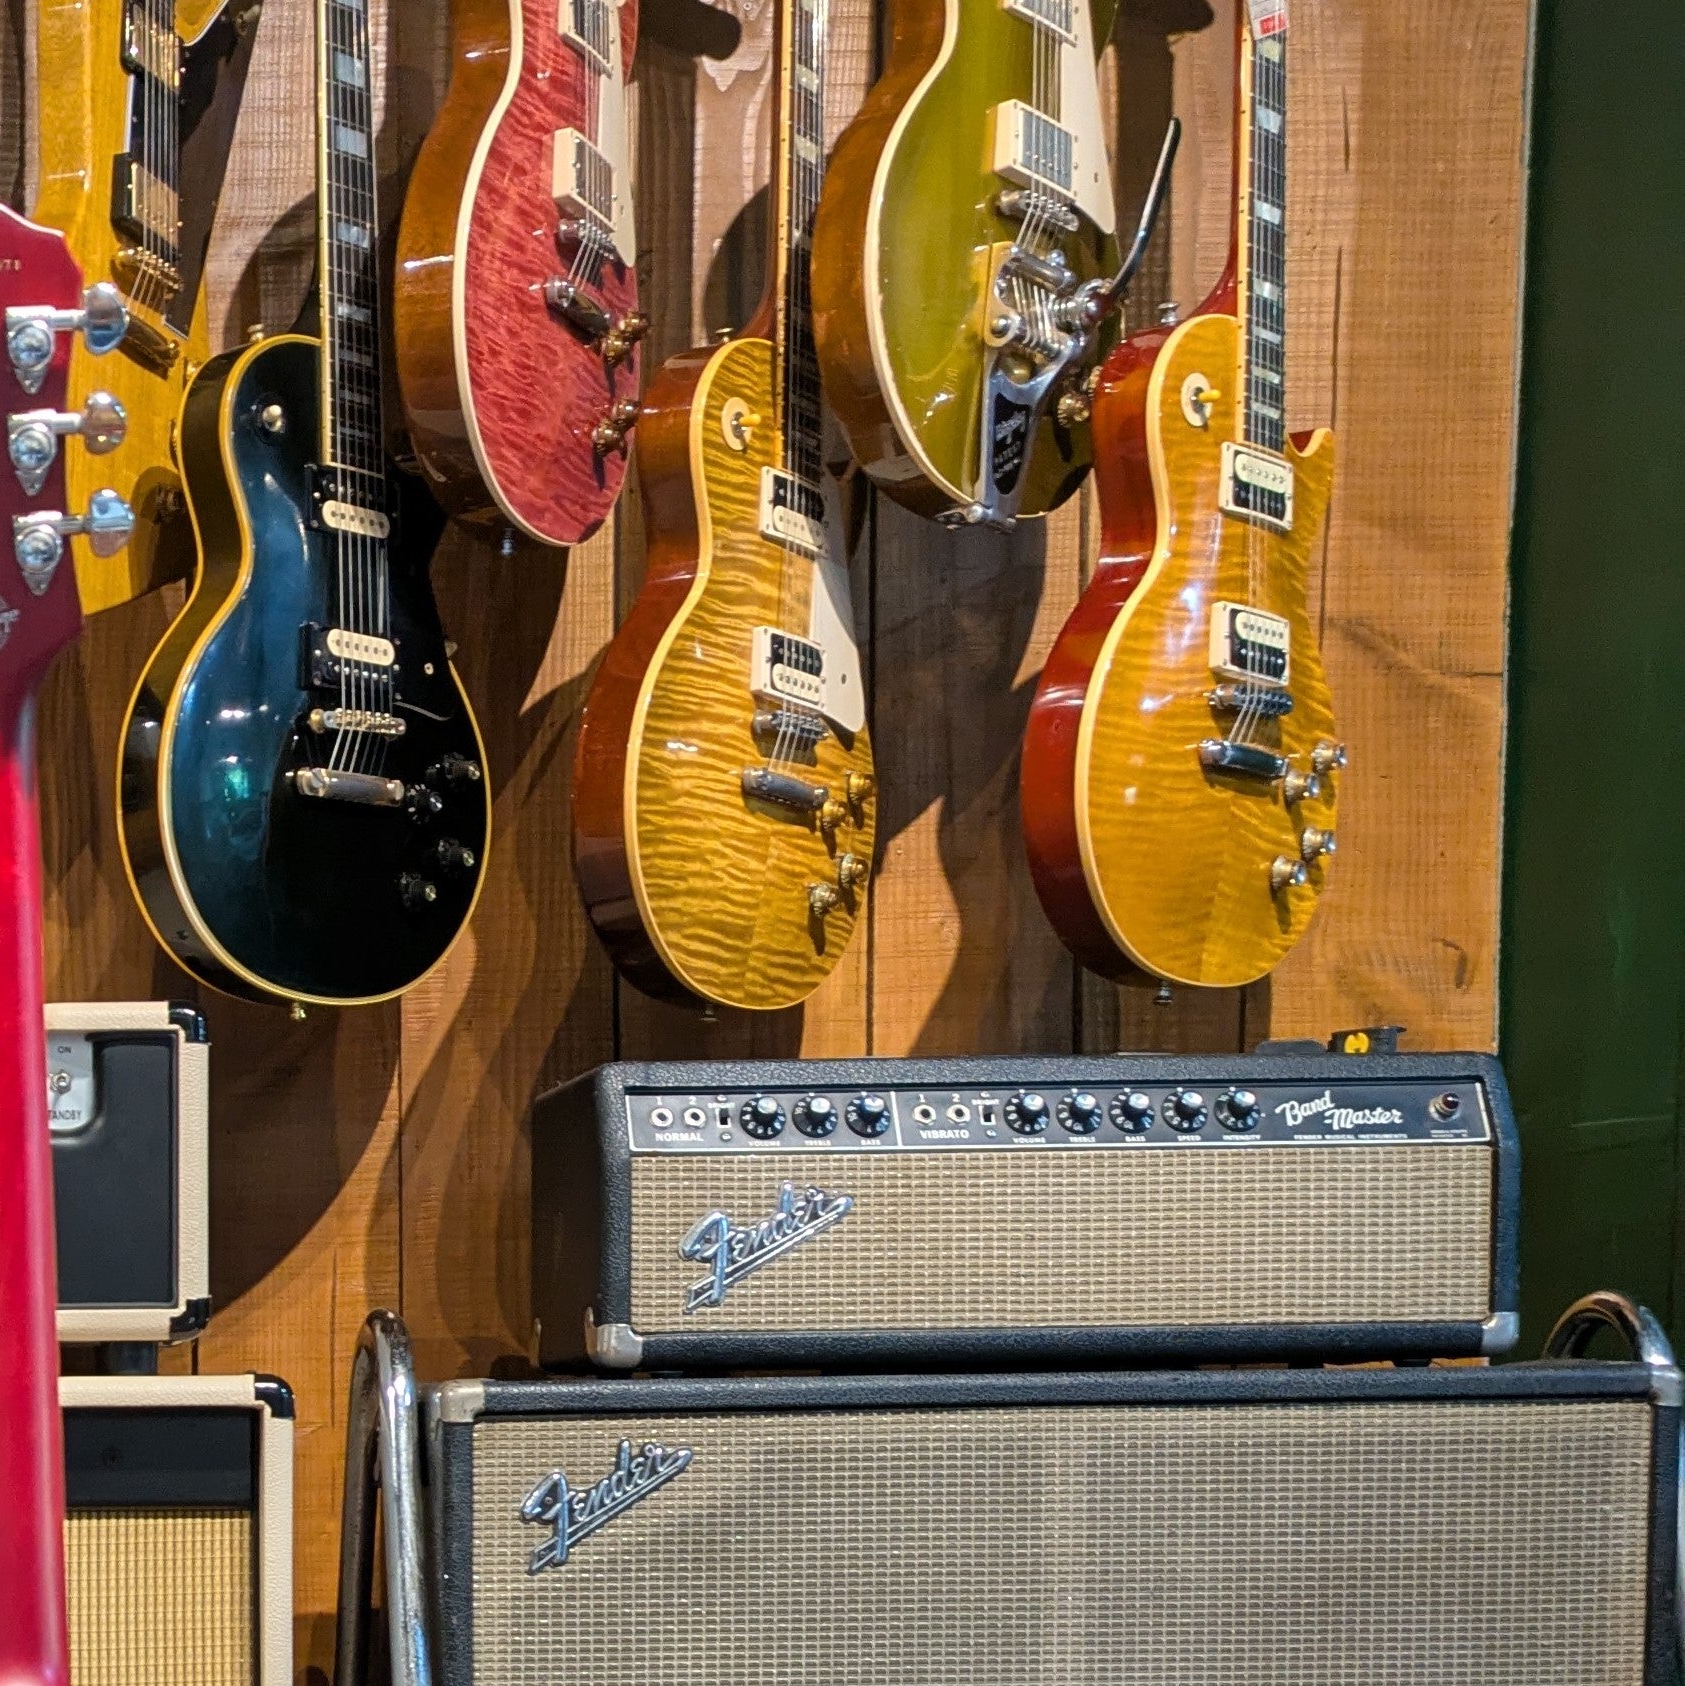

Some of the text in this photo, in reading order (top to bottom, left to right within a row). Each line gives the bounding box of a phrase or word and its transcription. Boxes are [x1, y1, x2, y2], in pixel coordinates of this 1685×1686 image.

[656, 1096, 663, 1106] 1
[689, 1096, 697, 1106] 2
[918, 1093, 926, 1103] 1
[952, 1093, 960, 1103] 2
[1275, 1090, 1335, 1127] Band
[48, 1109, 82, 1120] TANDBY
[1324, 1107, 1403, 1130] Master
[655, 1133, 704, 1142] NORMAL
[919, 1129, 970, 1139] VIBRATO
[1177, 1134, 1202, 1142] SPEED
[678, 1180, 855, 1315] Fender
[520, 1437, 694, 1576] Fender
